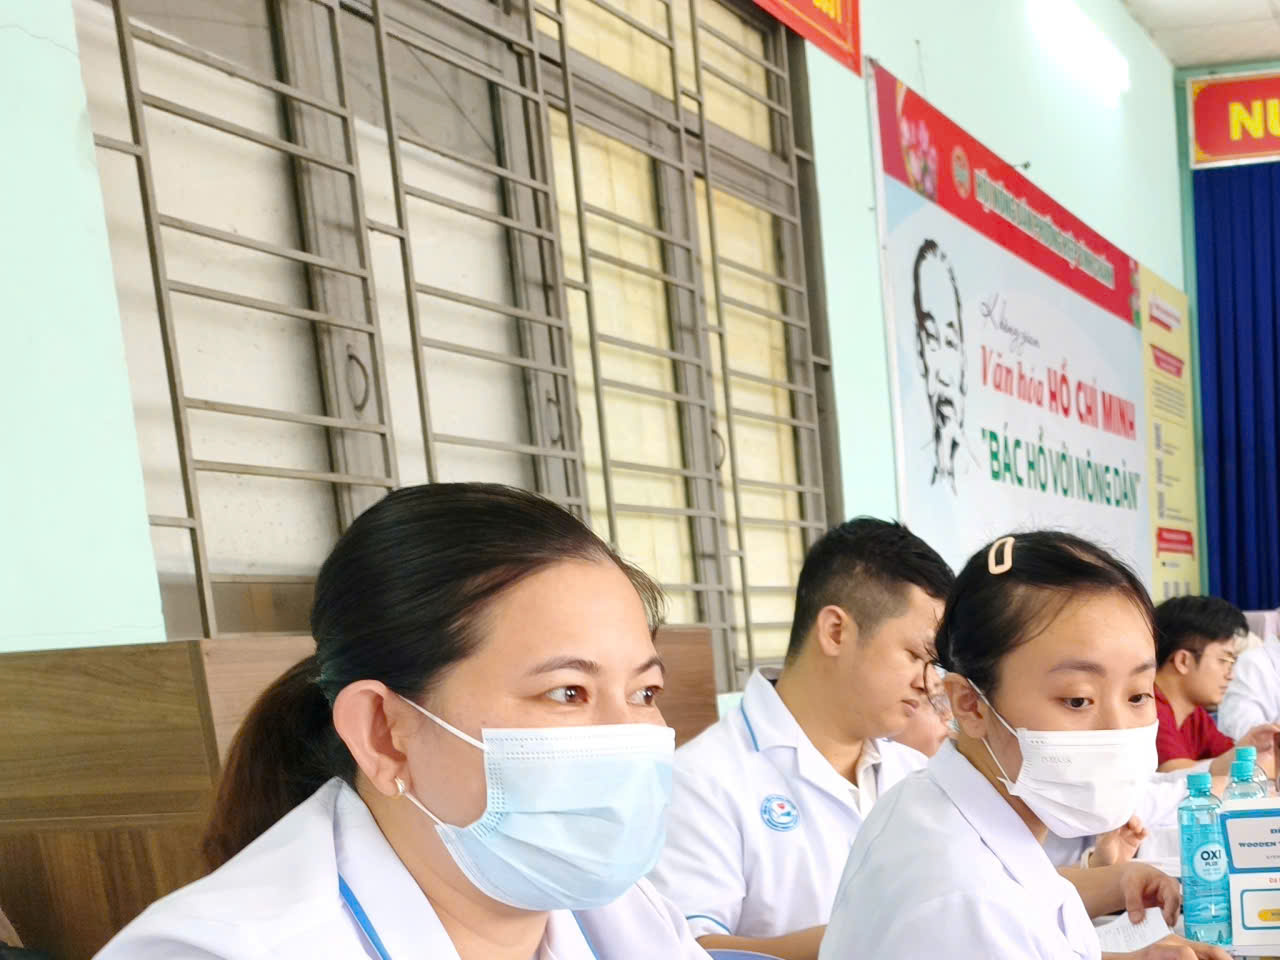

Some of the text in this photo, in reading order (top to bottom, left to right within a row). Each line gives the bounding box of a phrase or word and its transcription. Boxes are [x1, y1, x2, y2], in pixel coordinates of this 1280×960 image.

[1048, 357, 1071, 418] HỒ
[1102, 391, 1136, 441] MINH
[1075, 449, 1111, 506] NÔNG
[1200, 850, 1222, 861] OXI
